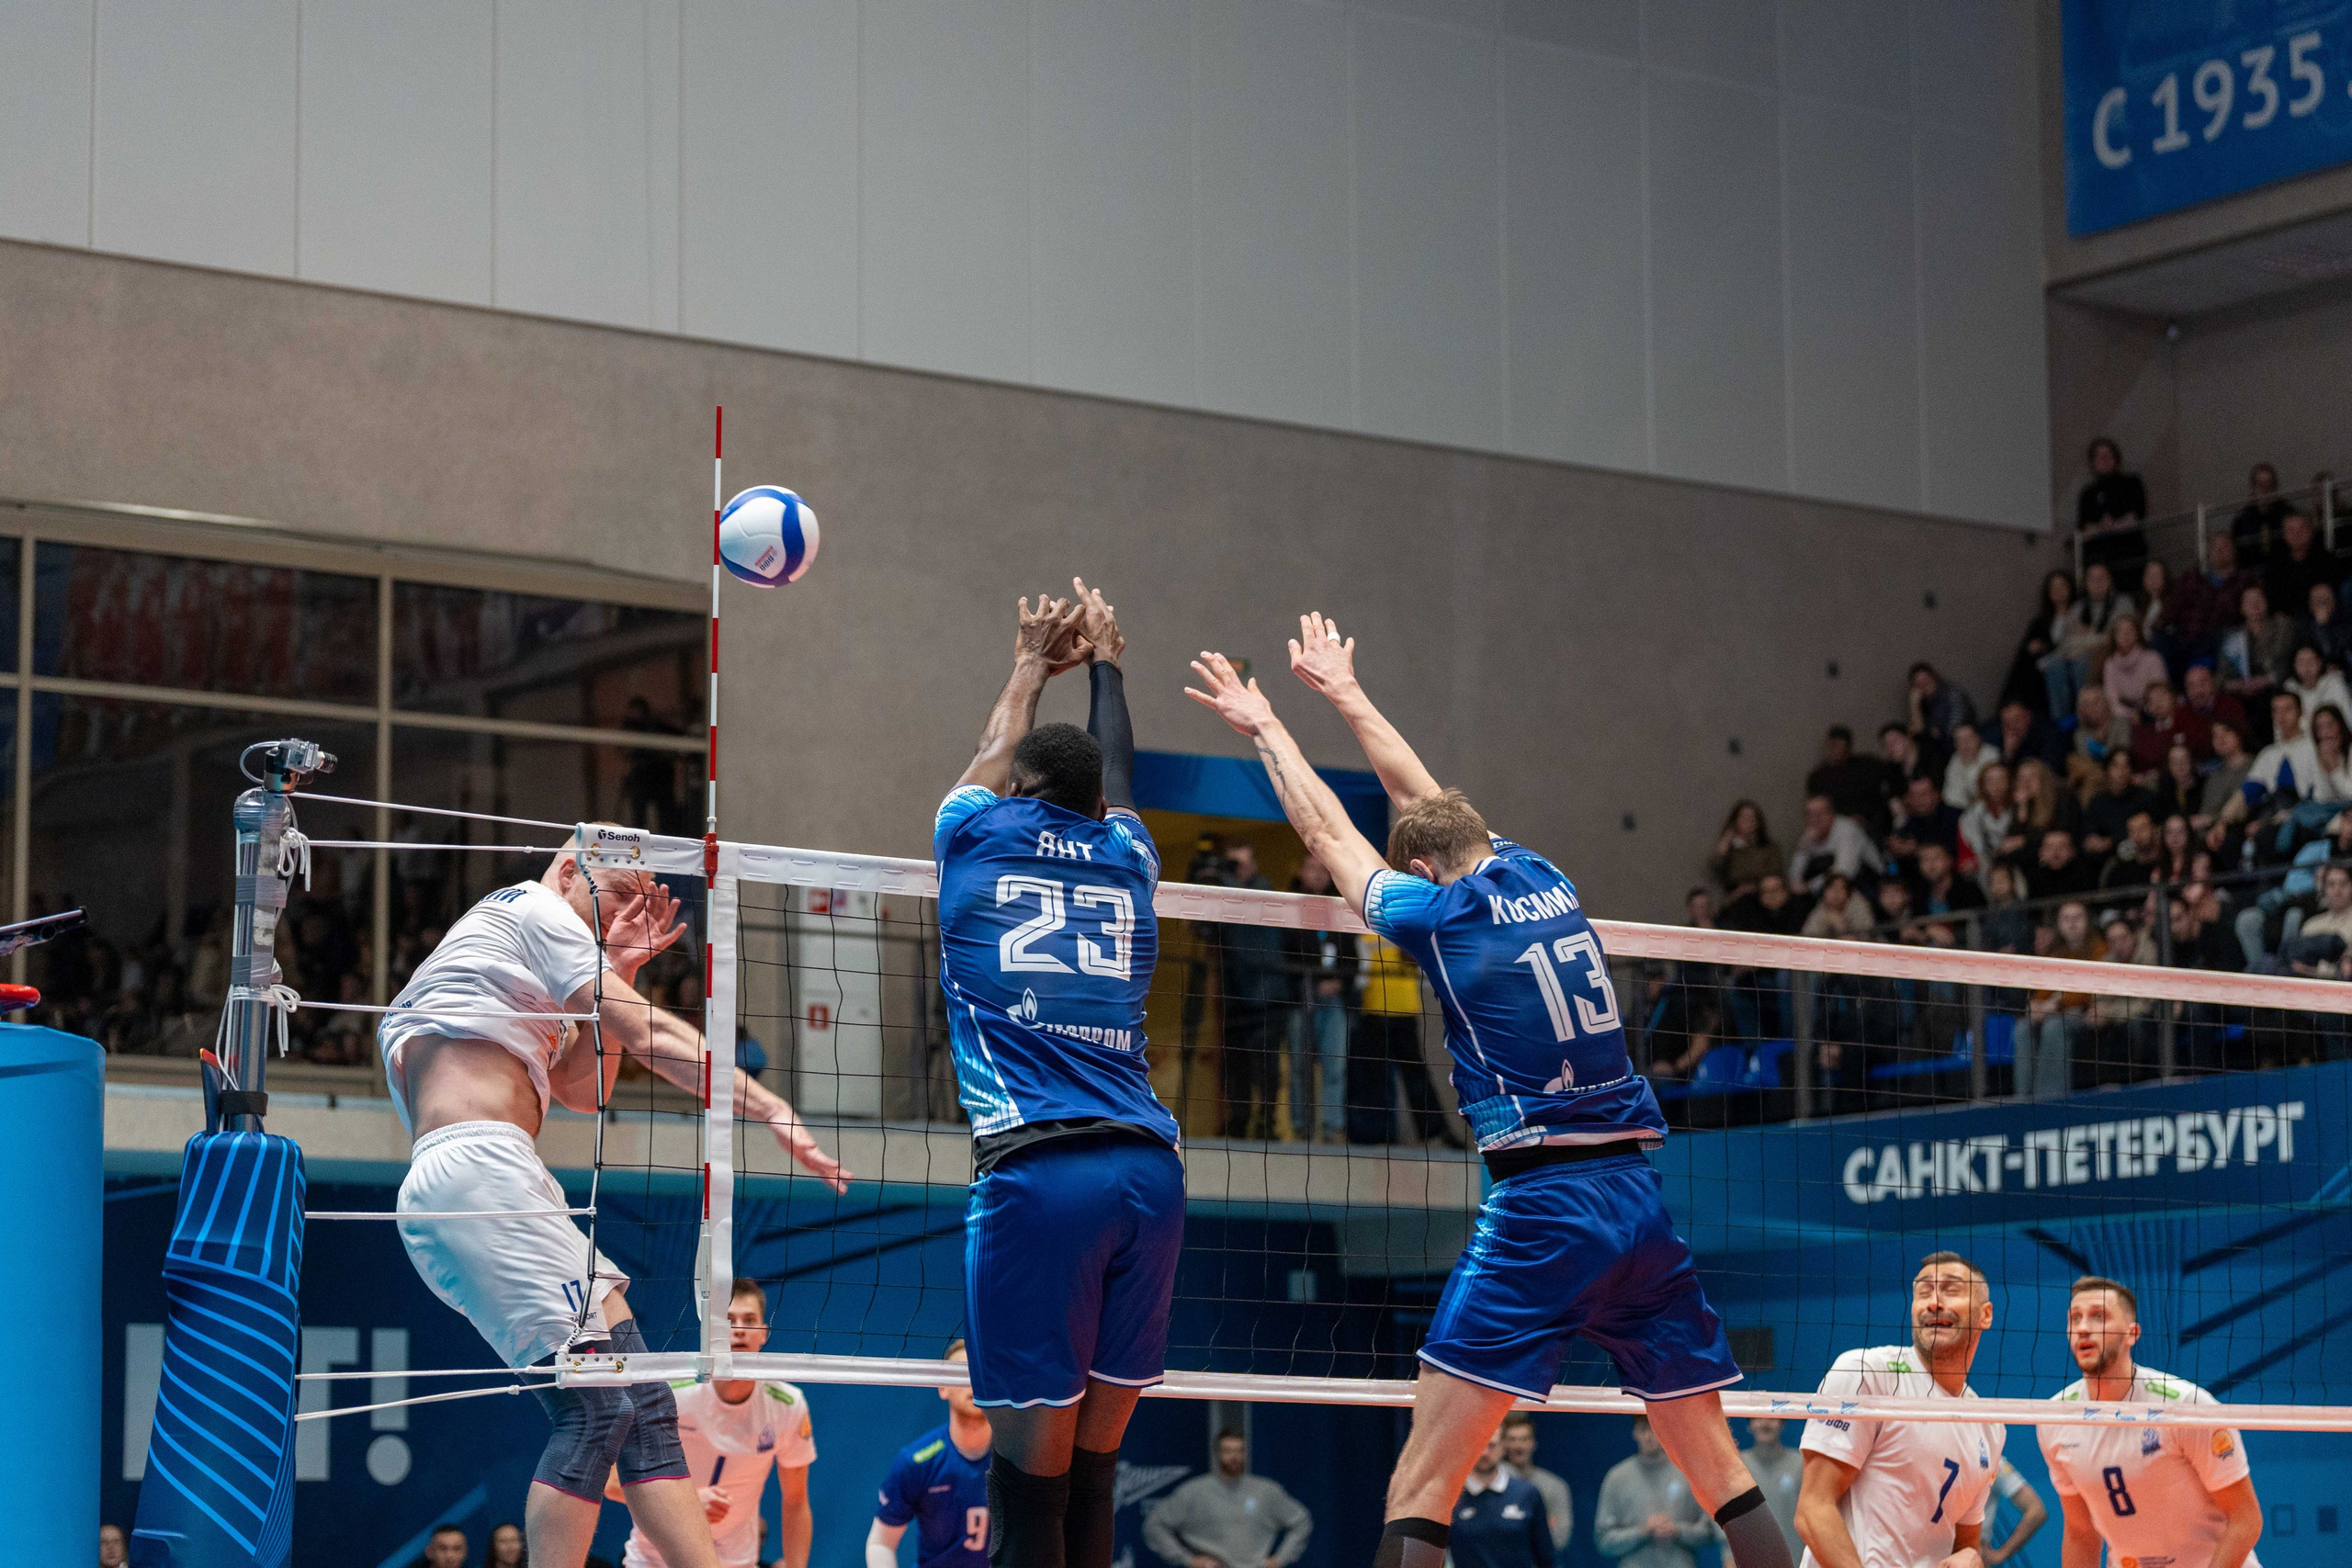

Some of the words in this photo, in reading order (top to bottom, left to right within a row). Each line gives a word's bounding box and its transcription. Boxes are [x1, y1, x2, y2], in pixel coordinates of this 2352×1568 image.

[2092, 87, 2132, 169] С
[2152, 31, 2325, 154] 1935
[607, 831, 640, 842] Senoh
[1036, 830, 1093, 861] ЯНТ
[996, 874, 1136, 981] 23
[1514, 931, 1622, 1043] 13
[1842, 1101, 2304, 1204] САНКТ-ПЕТЕРБУРГ
[561, 1280, 585, 1313] 17
[570, 1312, 597, 1323] ZAORT
[1930, 1457, 1960, 1524] 7
[2102, 1466, 2136, 1517] 8
[963, 1506, 989, 1552] 9
